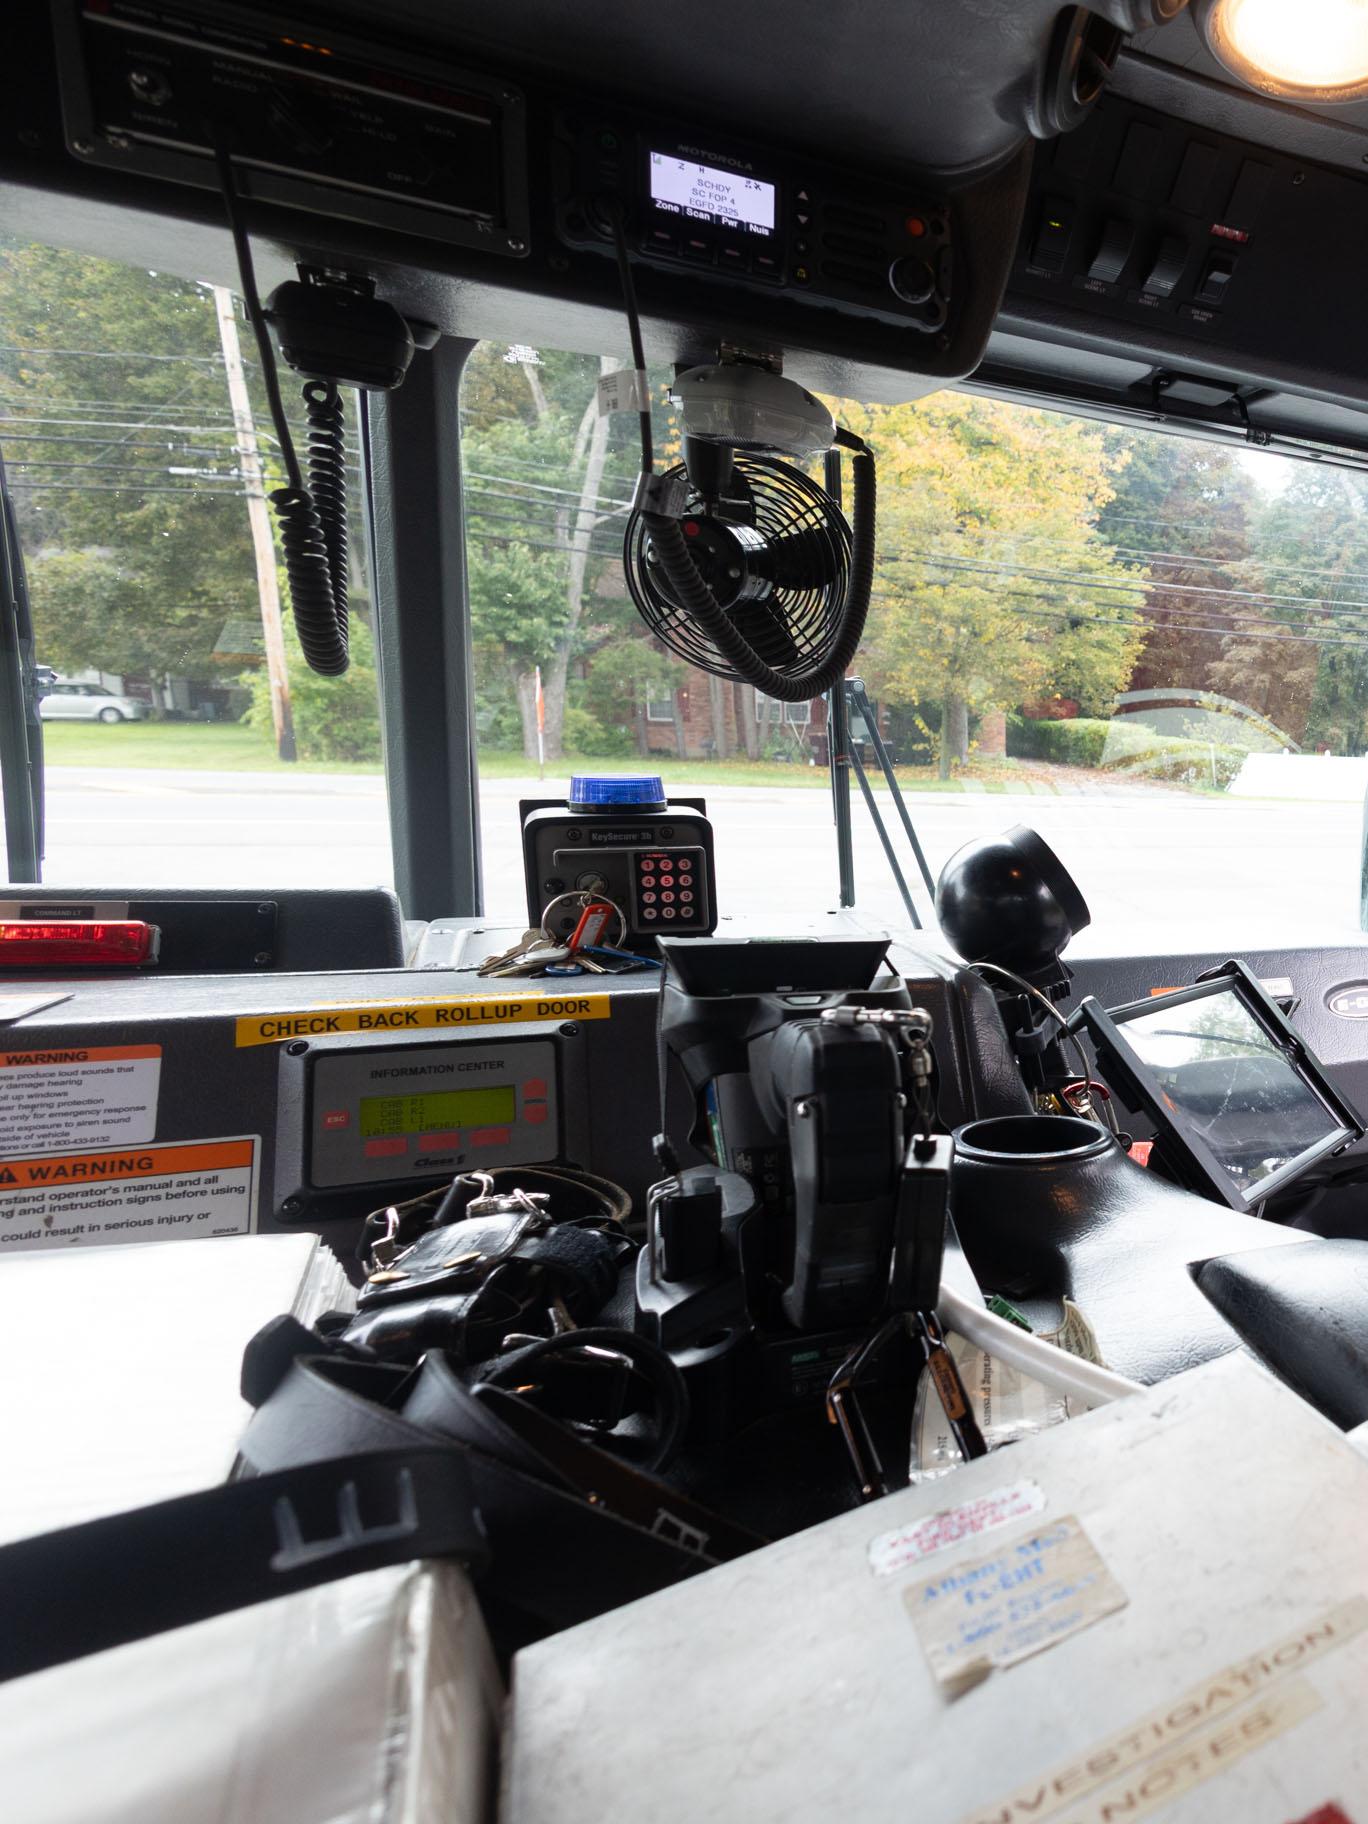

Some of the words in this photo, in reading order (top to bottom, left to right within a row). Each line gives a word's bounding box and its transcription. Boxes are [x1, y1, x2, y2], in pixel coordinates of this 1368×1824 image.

[677, 143, 753, 172] MOTOROLA
[692, 187, 706, 198] SC
[697, 178, 732, 194] SCHDY
[655, 200, 680, 214] Zone
[686, 207, 711, 221] Scan
[721, 216, 738, 228] Pwr
[749, 224, 769, 236] Nuis
[591, 832, 638, 843] KeySecure
[259, 1016, 341, 1038] CHECK
[358, 1009, 419, 1029] BACK
[435, 1003, 523, 1023] ROLLUP
[536, 1000, 591, 1016] DOOR
[6, 1051, 89, 1066] WARNING
[17, 1071, 56, 1081] produce
[81, 1067, 114, 1075] sounds
[117, 1065, 134, 1073] that
[370, 1063, 455, 1079] INFORMATION
[457, 1060, 505, 1072] CENTER
[6, 1081, 45, 1090] damage
[47, 1078, 83, 1087] hearing
[12, 1094, 24, 1102] up
[27, 1091, 69, 1099] windows
[18, 1101, 54, 1111] hearing
[57, 1098, 104, 1108] protection
[10, 1113, 31, 1122] only
[48, 1108, 100, 1119] emergency
[103, 1105, 147, 1114] response
[327, 1115, 345, 1123] ESC
[17, 1122, 62, 1133] exposure
[76, 1119, 100, 1127] siren
[102, 1117, 132, 1125] sound
[24, 1133, 34, 1141] of
[36, 1131, 70, 1139] vehicle
[28, 1157, 154, 1181] WARNING
[49, 1185, 120, 1202] operator's
[123, 1180, 173, 1193] manual
[176, 1176, 201, 1187] and
[203, 1175, 219, 1184] all
[18, 1205, 46, 1216] and
[49, 1197, 123, 1213] instruction
[126, 1193, 162, 1207] signs
[165, 1188, 208, 1200] before
[211, 1184, 246, 1198] using
[1, 1229, 41, 1242] could
[45, 1225, 85, 1237] result
[88, 1222, 101, 1232] in
[104, 1217, 154, 1230] serious
[157, 1212, 194, 1226] injury
[197, 1211, 212, 1221] or
[981, 1350, 993, 1388] erating
[1101, 1710, 1274, 1822] NOTES
